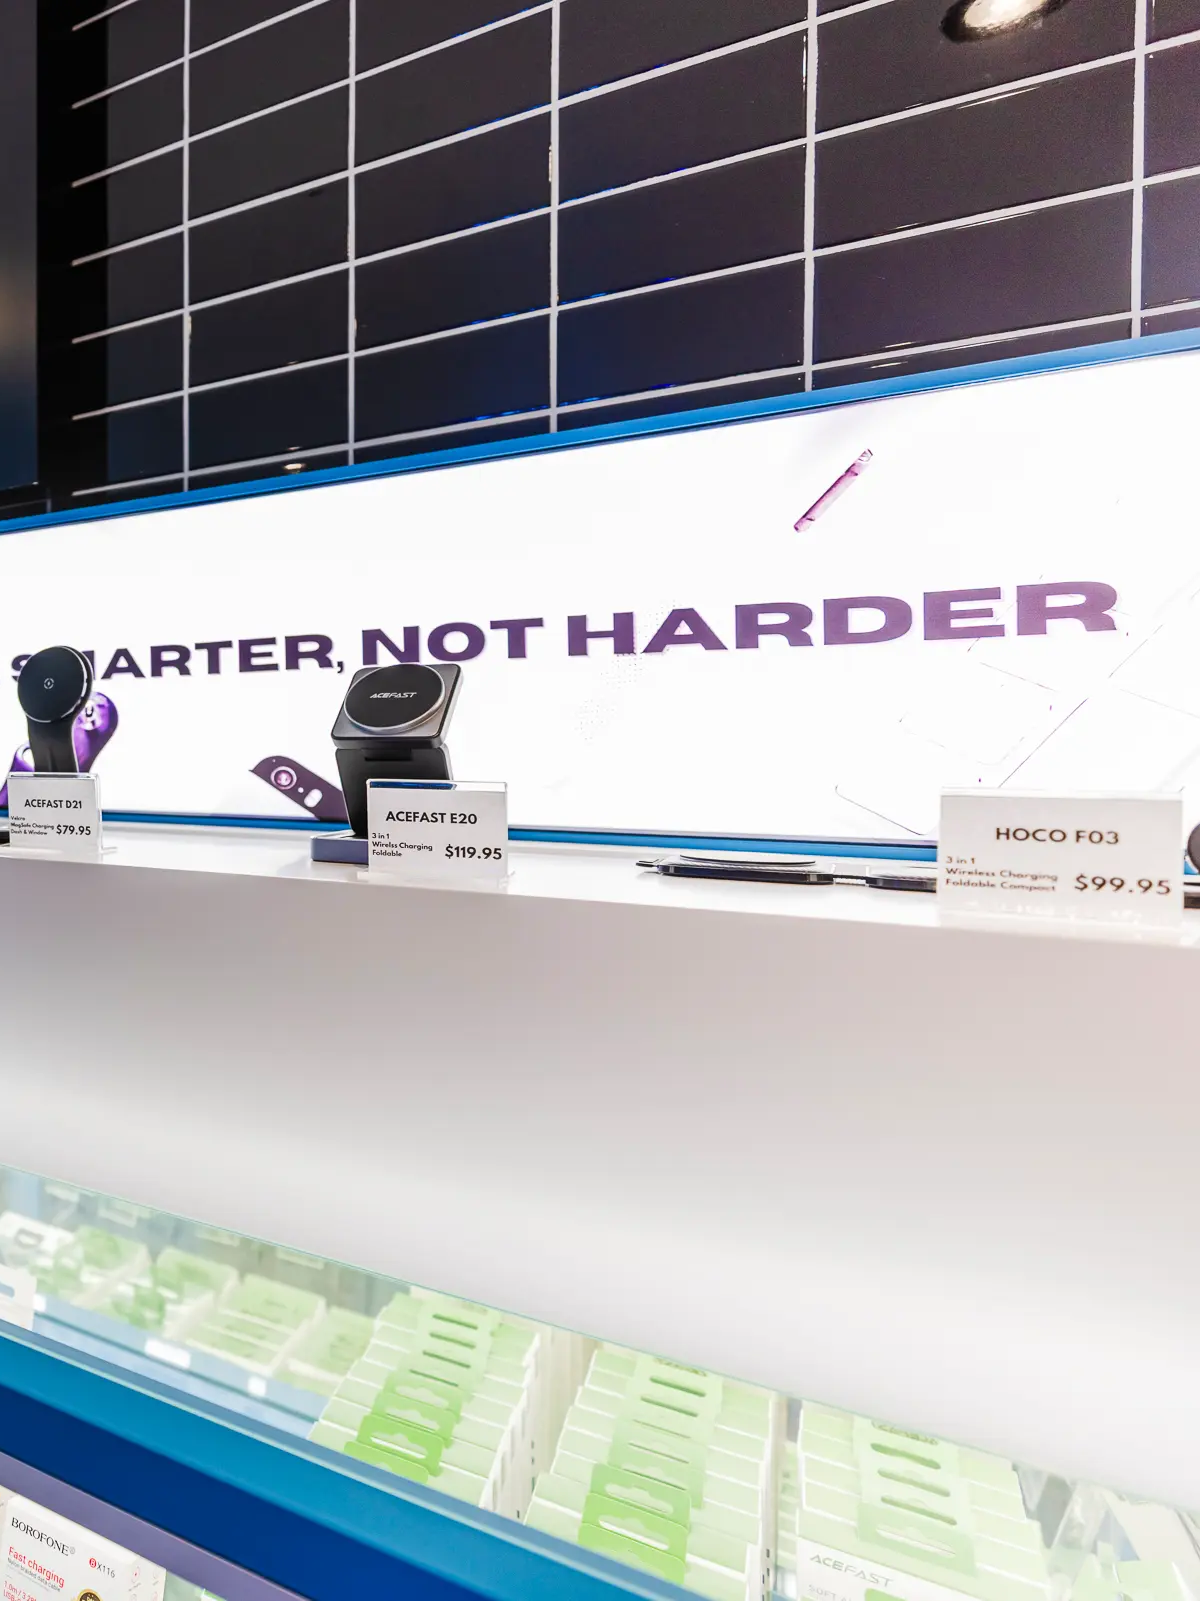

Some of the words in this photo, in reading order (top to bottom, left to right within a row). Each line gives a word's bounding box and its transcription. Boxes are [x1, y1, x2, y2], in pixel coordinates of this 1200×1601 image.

[362, 616, 544, 665] NOT
[567, 580, 1118, 656] HARDER
[370, 691, 418, 699] ACEFAST
[24, 799, 63, 808] ACEFAST
[65, 800, 82, 809] D21
[385, 811, 446, 823] ACEFAST
[450, 813, 478, 825] E20
[32, 823, 54, 831] Charging
[56, 824, 91, 836] $79.95
[996, 827, 1067, 843] HOCO
[1075, 830, 1119, 845] F03
[372, 849, 402, 857] Foldable
[399, 842, 433, 852] Charging
[445, 844, 502, 860] $119.95
[946, 856, 953, 864] 3
[956, 856, 968, 865] in
[946, 867, 996, 877] Wireless
[1000, 869, 1058, 883] Charging
[945, 878, 996, 889] Foldable
[1000, 881, 1056, 892] Compact
[1074, 873, 1171, 895] $99.95
[11, 1516, 70, 1557] BOROFONE
[8, 1546, 26, 1565] Fast
[27, 1557, 65, 1589] charging
[809, 1553, 895, 1588] ACEFAST
